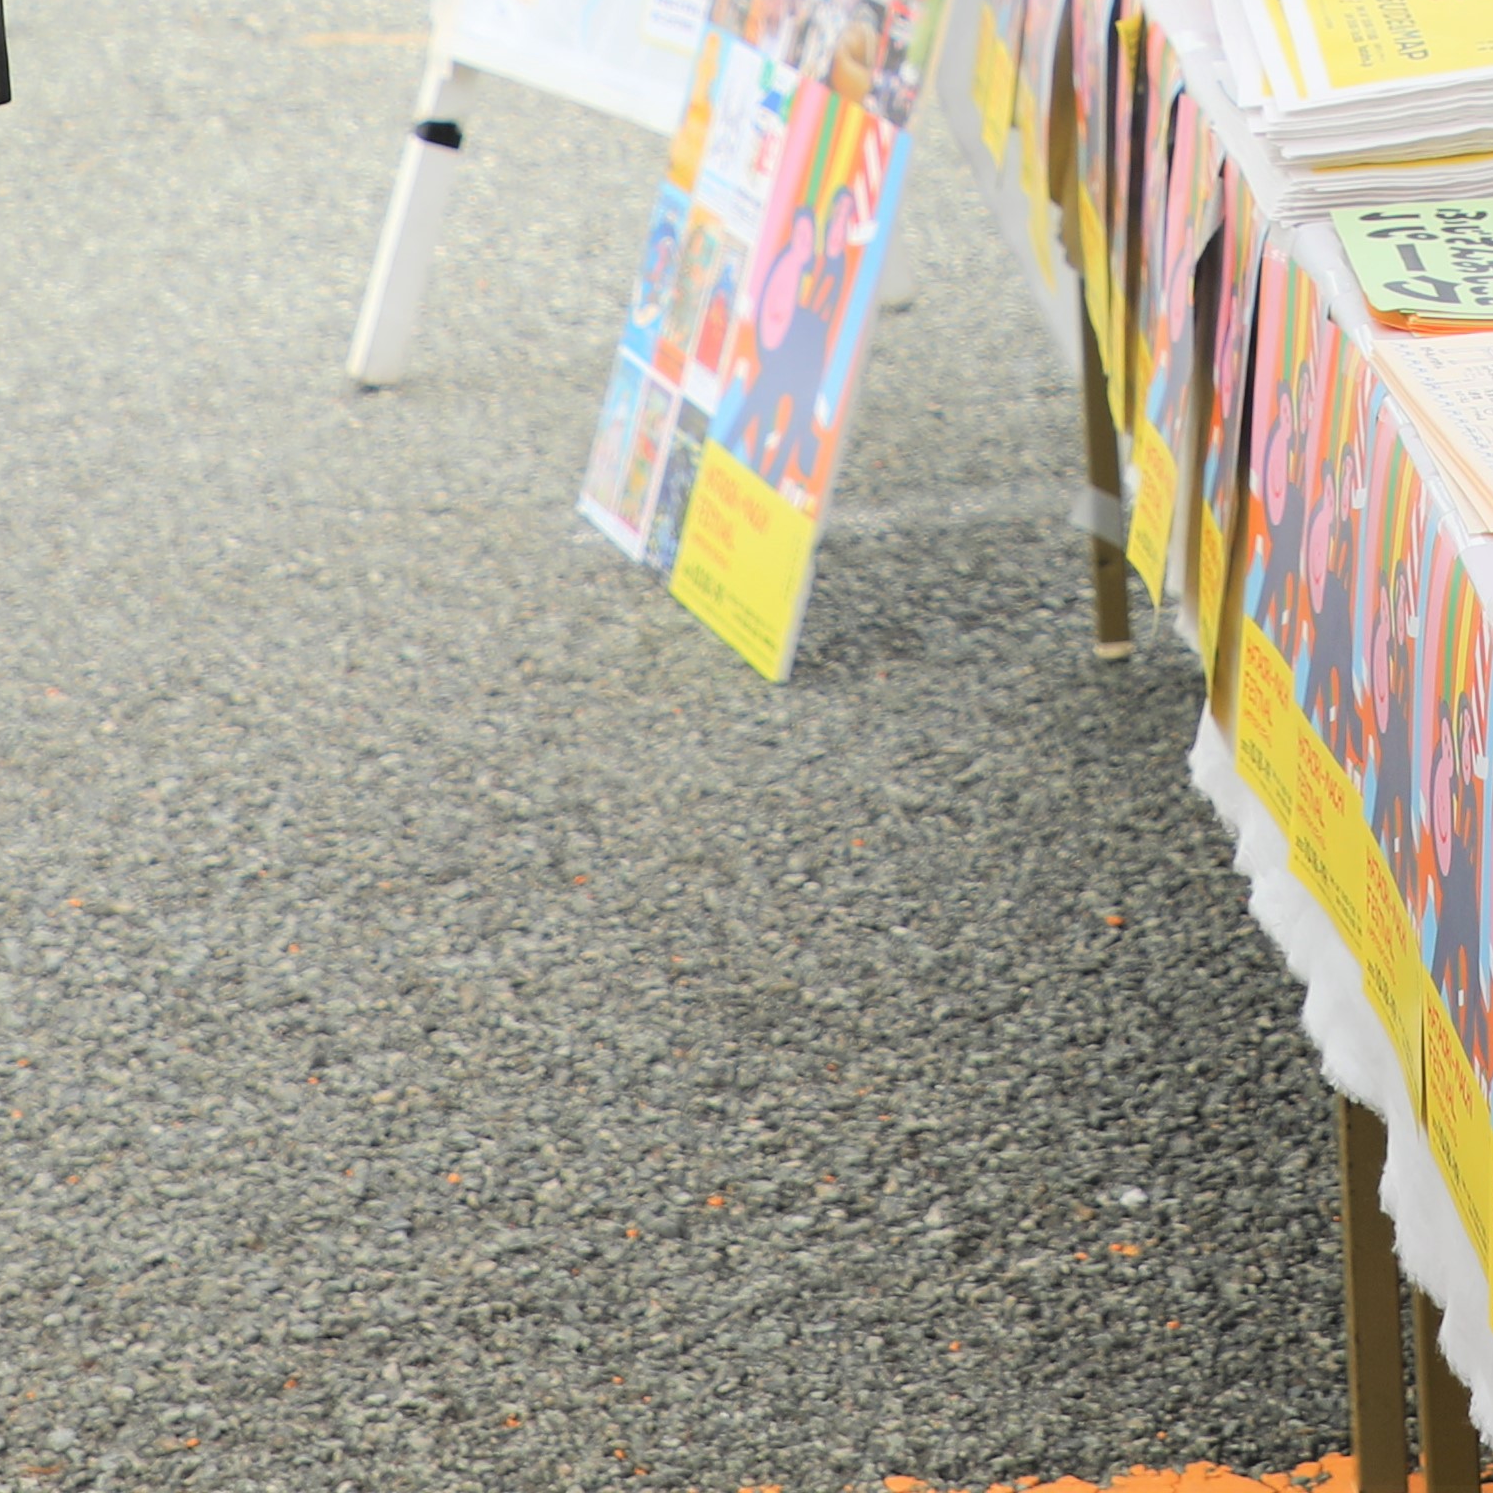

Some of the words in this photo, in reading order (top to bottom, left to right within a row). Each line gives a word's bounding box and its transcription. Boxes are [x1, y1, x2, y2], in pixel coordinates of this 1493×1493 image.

[1357, 210, 1464, 305] パーク
[1426, 1036, 1458, 1124] FESTIVAL
